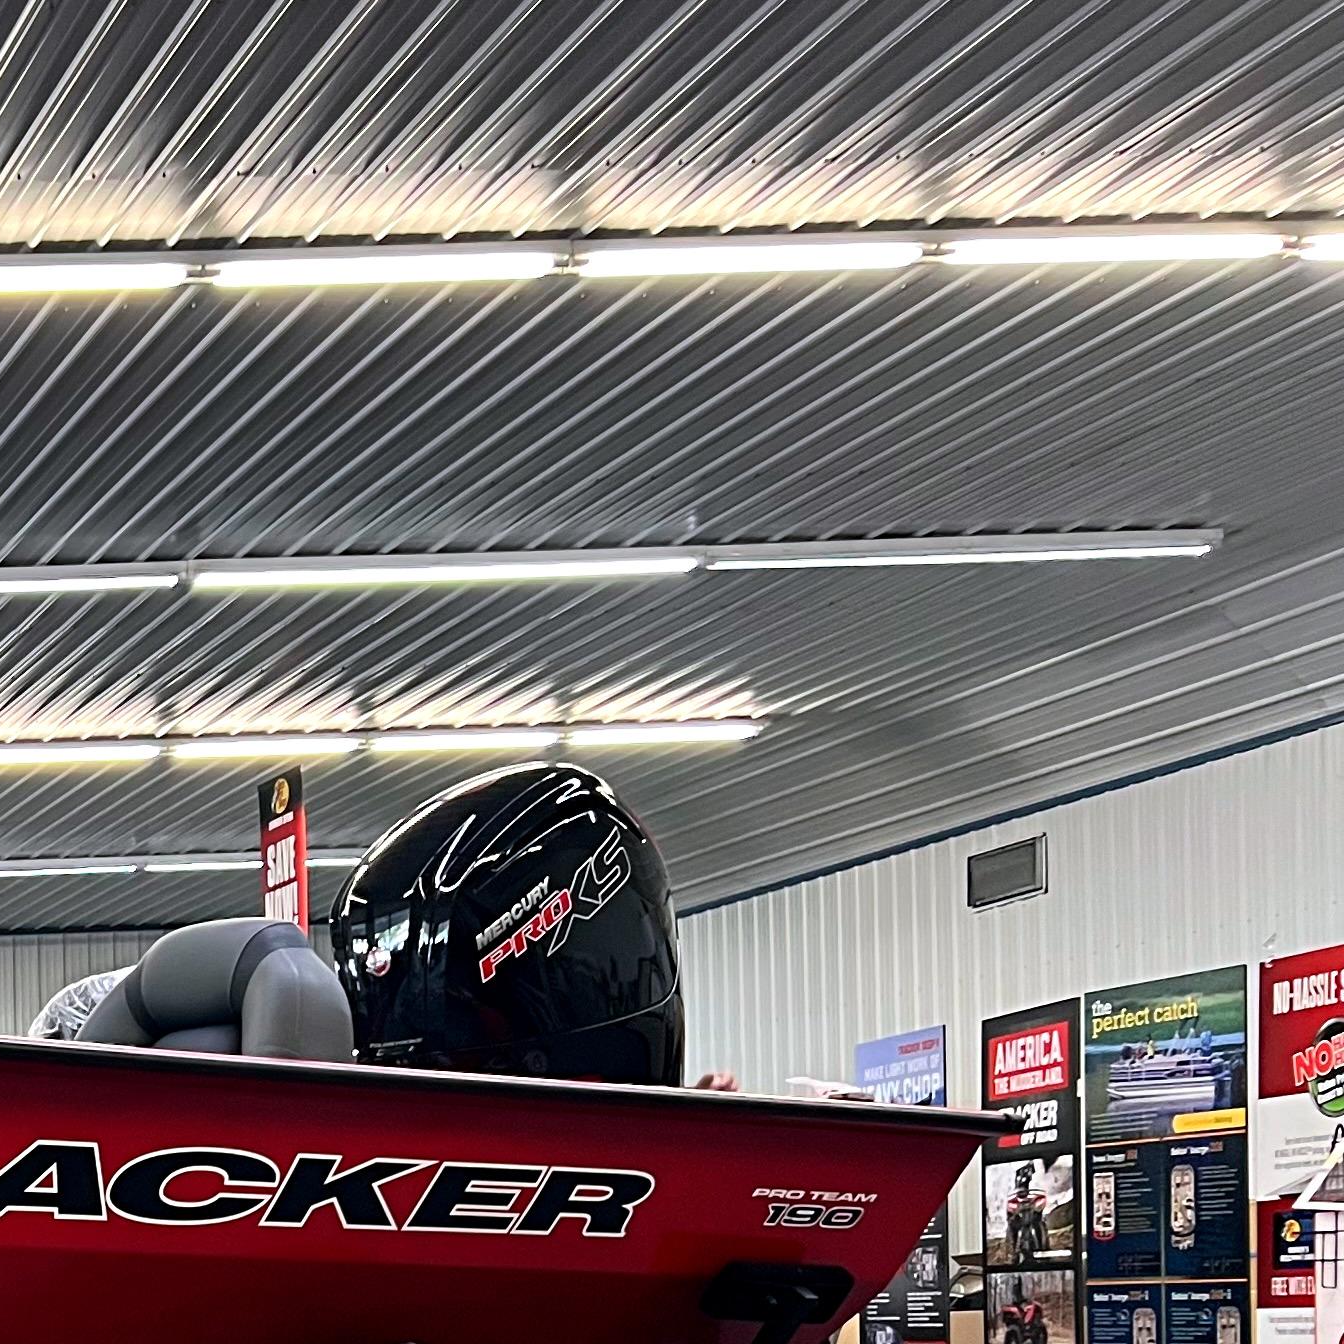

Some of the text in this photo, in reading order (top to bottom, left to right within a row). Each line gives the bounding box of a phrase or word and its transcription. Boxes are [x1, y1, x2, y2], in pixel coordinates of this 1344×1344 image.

[267, 835, 296, 888] SAVE
[475, 875, 550, 951] MERCURY
[1091, 1000, 1113, 1017] the
[1272, 969, 1339, 1015] NO-HASSLE
[1091, 995, 1199, 1039] perfect catch
[751, 1187, 878, 1203] PRO TEAM
[762, 1203, 865, 1229] 190
